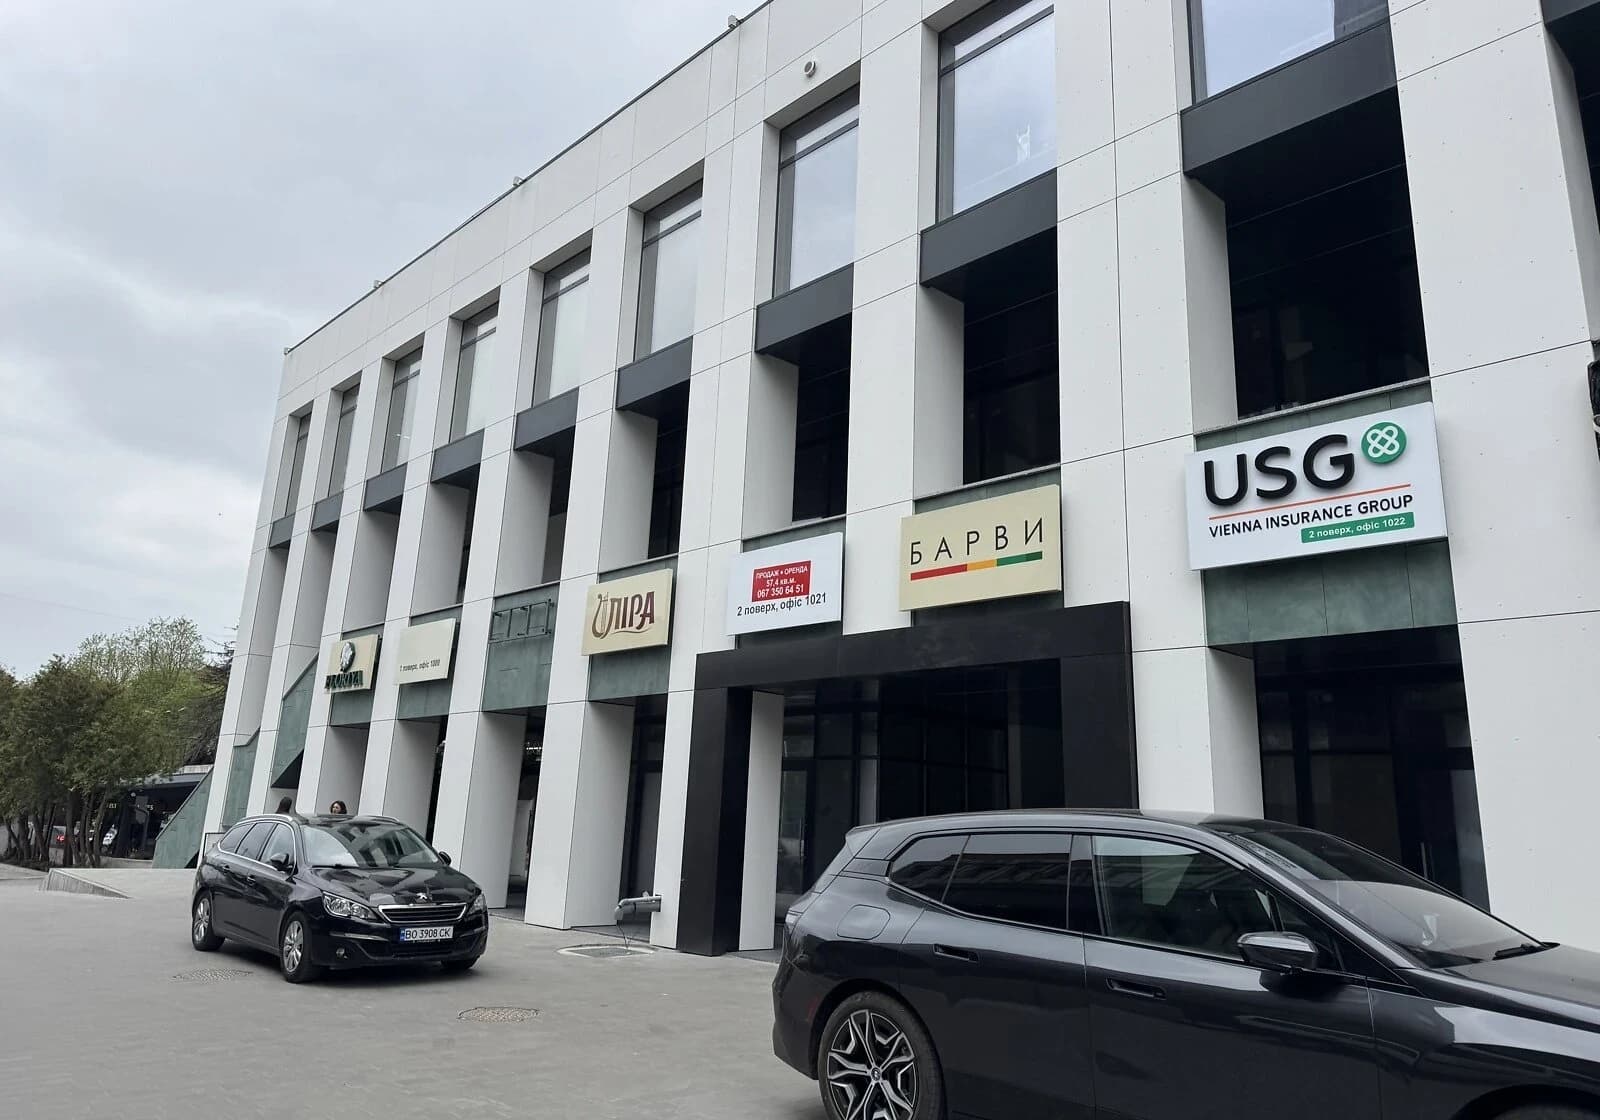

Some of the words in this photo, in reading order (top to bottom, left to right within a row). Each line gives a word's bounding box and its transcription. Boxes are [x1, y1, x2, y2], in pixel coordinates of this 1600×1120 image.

[1203, 434, 1355, 507] USG
[1209, 519, 1262, 538] VIENNA
[1265, 504, 1352, 530] INSURANCE
[1357, 494, 1413, 515] GROUP
[1309, 530, 1315, 539] 2
[1317, 526, 1354, 537] поверх,
[1356, 520, 1380, 533] офіс
[1382, 517, 1406, 528] 1022
[910, 517, 1043, 565] БАРВИ
[756, 569, 780, 579] ПРОДАЖ
[784, 565, 808, 575] ОРЕНДА
[757, 588, 770, 599] 067
[771, 587, 784, 597] 350
[785, 585, 794, 594] 64
[795, 584, 804, 593] 51
[737, 606, 743, 617] 2
[744, 602, 779, 615] поверх,
[780, 596, 802, 611] офіс
[805, 592, 827, 606] 1021
[406, 930, 417, 939] BO
[419, 929, 437, 938] 3908
[440, 928, 451, 937] CK
